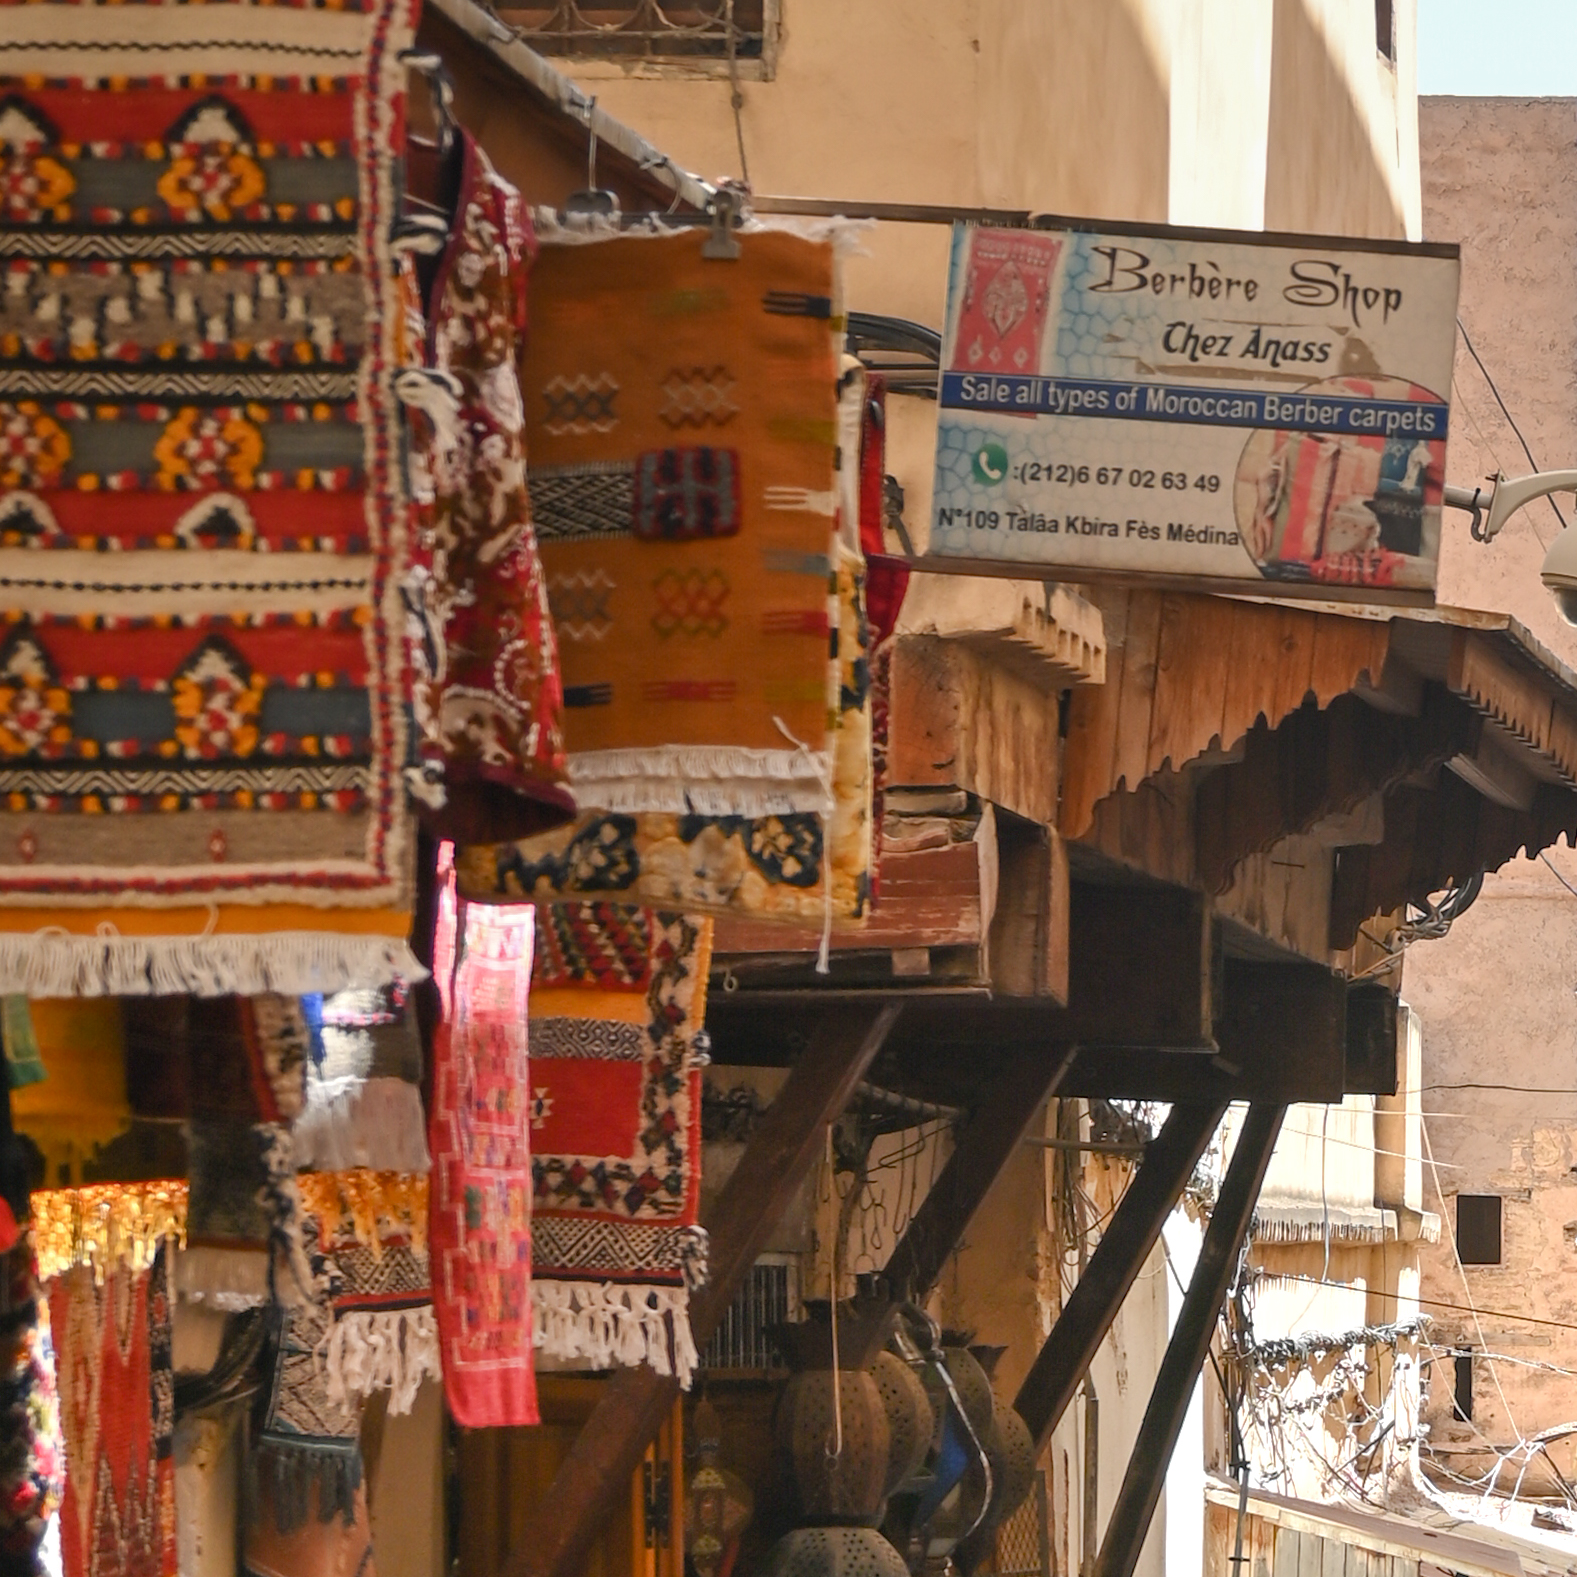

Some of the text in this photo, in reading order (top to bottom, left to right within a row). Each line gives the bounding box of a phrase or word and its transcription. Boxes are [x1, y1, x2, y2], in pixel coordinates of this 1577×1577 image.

[1087, 245, 1403, 327] Berbère Shop
[1163, 322, 1332, 367] Chez Anass
[960, 376, 1436, 435] Sale all types of Moroccan Berber carpets
[1095, 467, 1123, 486] 67
[1128, 469, 1155, 489] 02
[1161, 472, 1187, 491] 63
[1193, 474, 1220, 493] 49
[1064, 515, 1119, 538] Kbira
[1125, 519, 1160, 541] Fès
[1166, 522, 1240, 546] Médina
